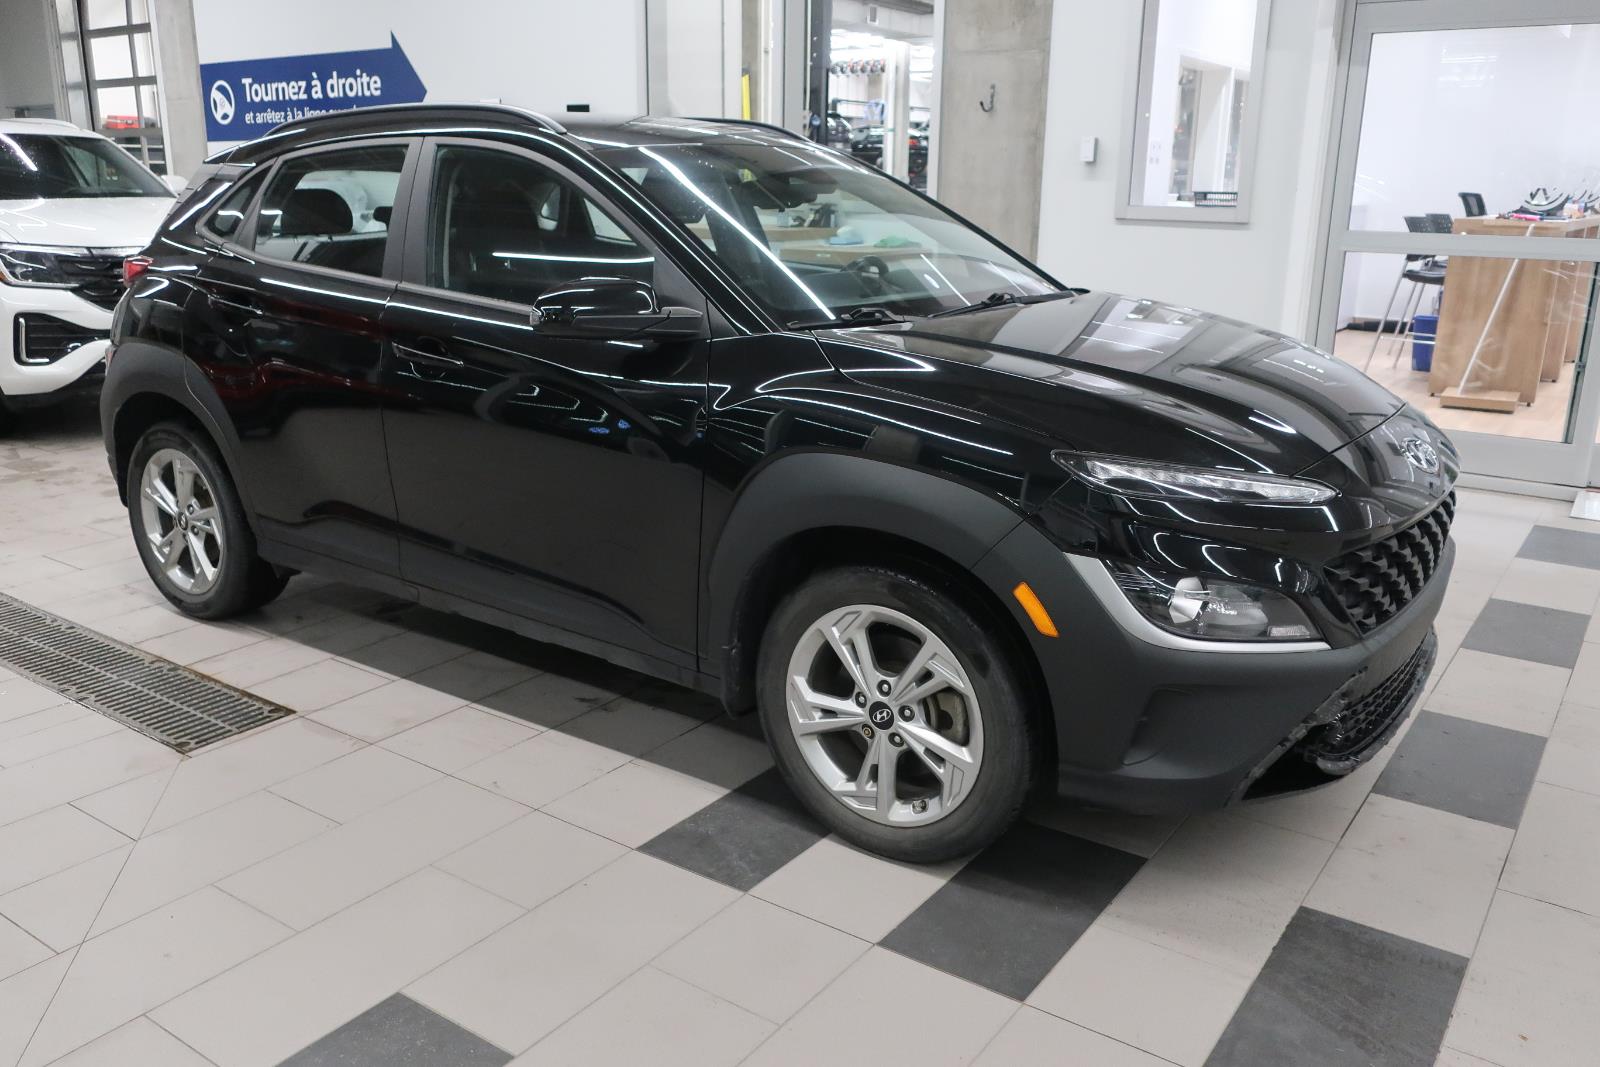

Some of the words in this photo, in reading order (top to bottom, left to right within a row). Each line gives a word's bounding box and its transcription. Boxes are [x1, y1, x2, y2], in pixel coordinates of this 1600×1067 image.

[241, 77, 308, 103] Tournez
[311, 71, 323, 99] à
[326, 68, 382, 98] droite
[245, 110, 255, 124] et
[255, 108, 286, 124] arrêtez
[286, 107, 293, 122] à
[294, 107, 303, 120] la
